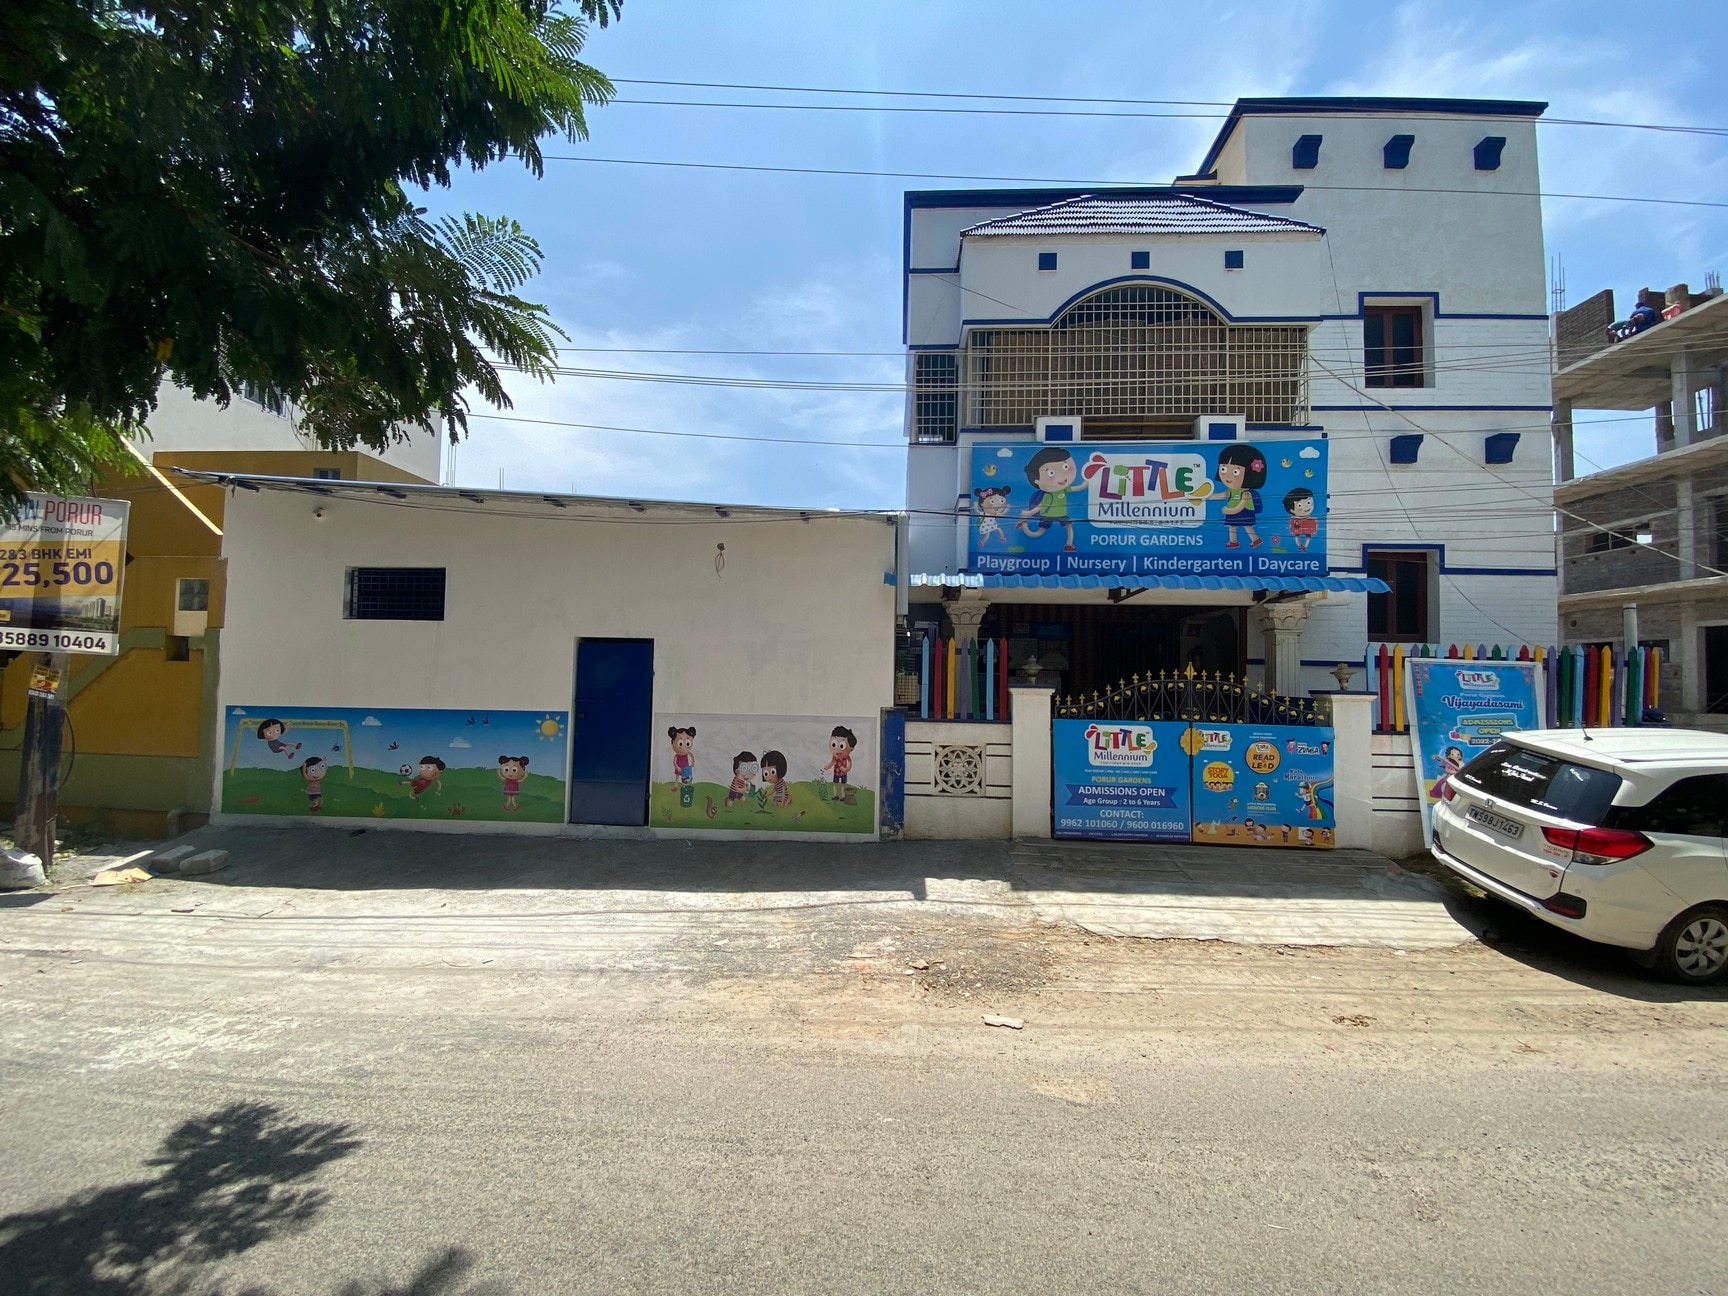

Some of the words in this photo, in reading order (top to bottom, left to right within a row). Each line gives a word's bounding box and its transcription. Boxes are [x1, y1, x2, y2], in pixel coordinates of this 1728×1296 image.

[44, 500, 103, 525] PORUR
[1098, 502, 1196, 518] Millennium
[18, 524, 39, 533] MINS
[40, 526, 63, 535] FROM
[65, 528, 94, 537] PORUR
[1090, 535, 1137, 546] PORUR
[1140, 535, 1203, 546] GARDENS
[32, 548, 63, 560] BHK
[66, 548, 92, 559] EMI
[977, 555, 1050, 572] Playgroup
[1067, 555, 1127, 572] Nursery
[1144, 556, 1243, 573] Kindergarten
[1258, 557, 1320, 573] Daycare
[2, 561, 113, 588] 25,500
[0, 632, 49, 647] 5889
[54, 635, 106, 650] 10404
[1442, 696, 1524, 710] Vijayadasami
[1094, 751, 1148, 761] Millennium
[1091, 776, 1116, 784] PORUR
[1117, 776, 1152, 784] GARDENS
[1078, 786, 1138, 796] ADMISSIONS
[1140, 787, 1166, 797] OPEN
[1083, 797, 1096, 805] Age
[1097, 798, 1118, 806] Group
[1099, 810, 1145, 819] CONTACT:
[1060, 819, 1082, 827] 9962
[1085, 819, 1118, 828] 101060
[1126, 821, 1149, 829] 9600
[1150, 821, 1184, 830] 016960
